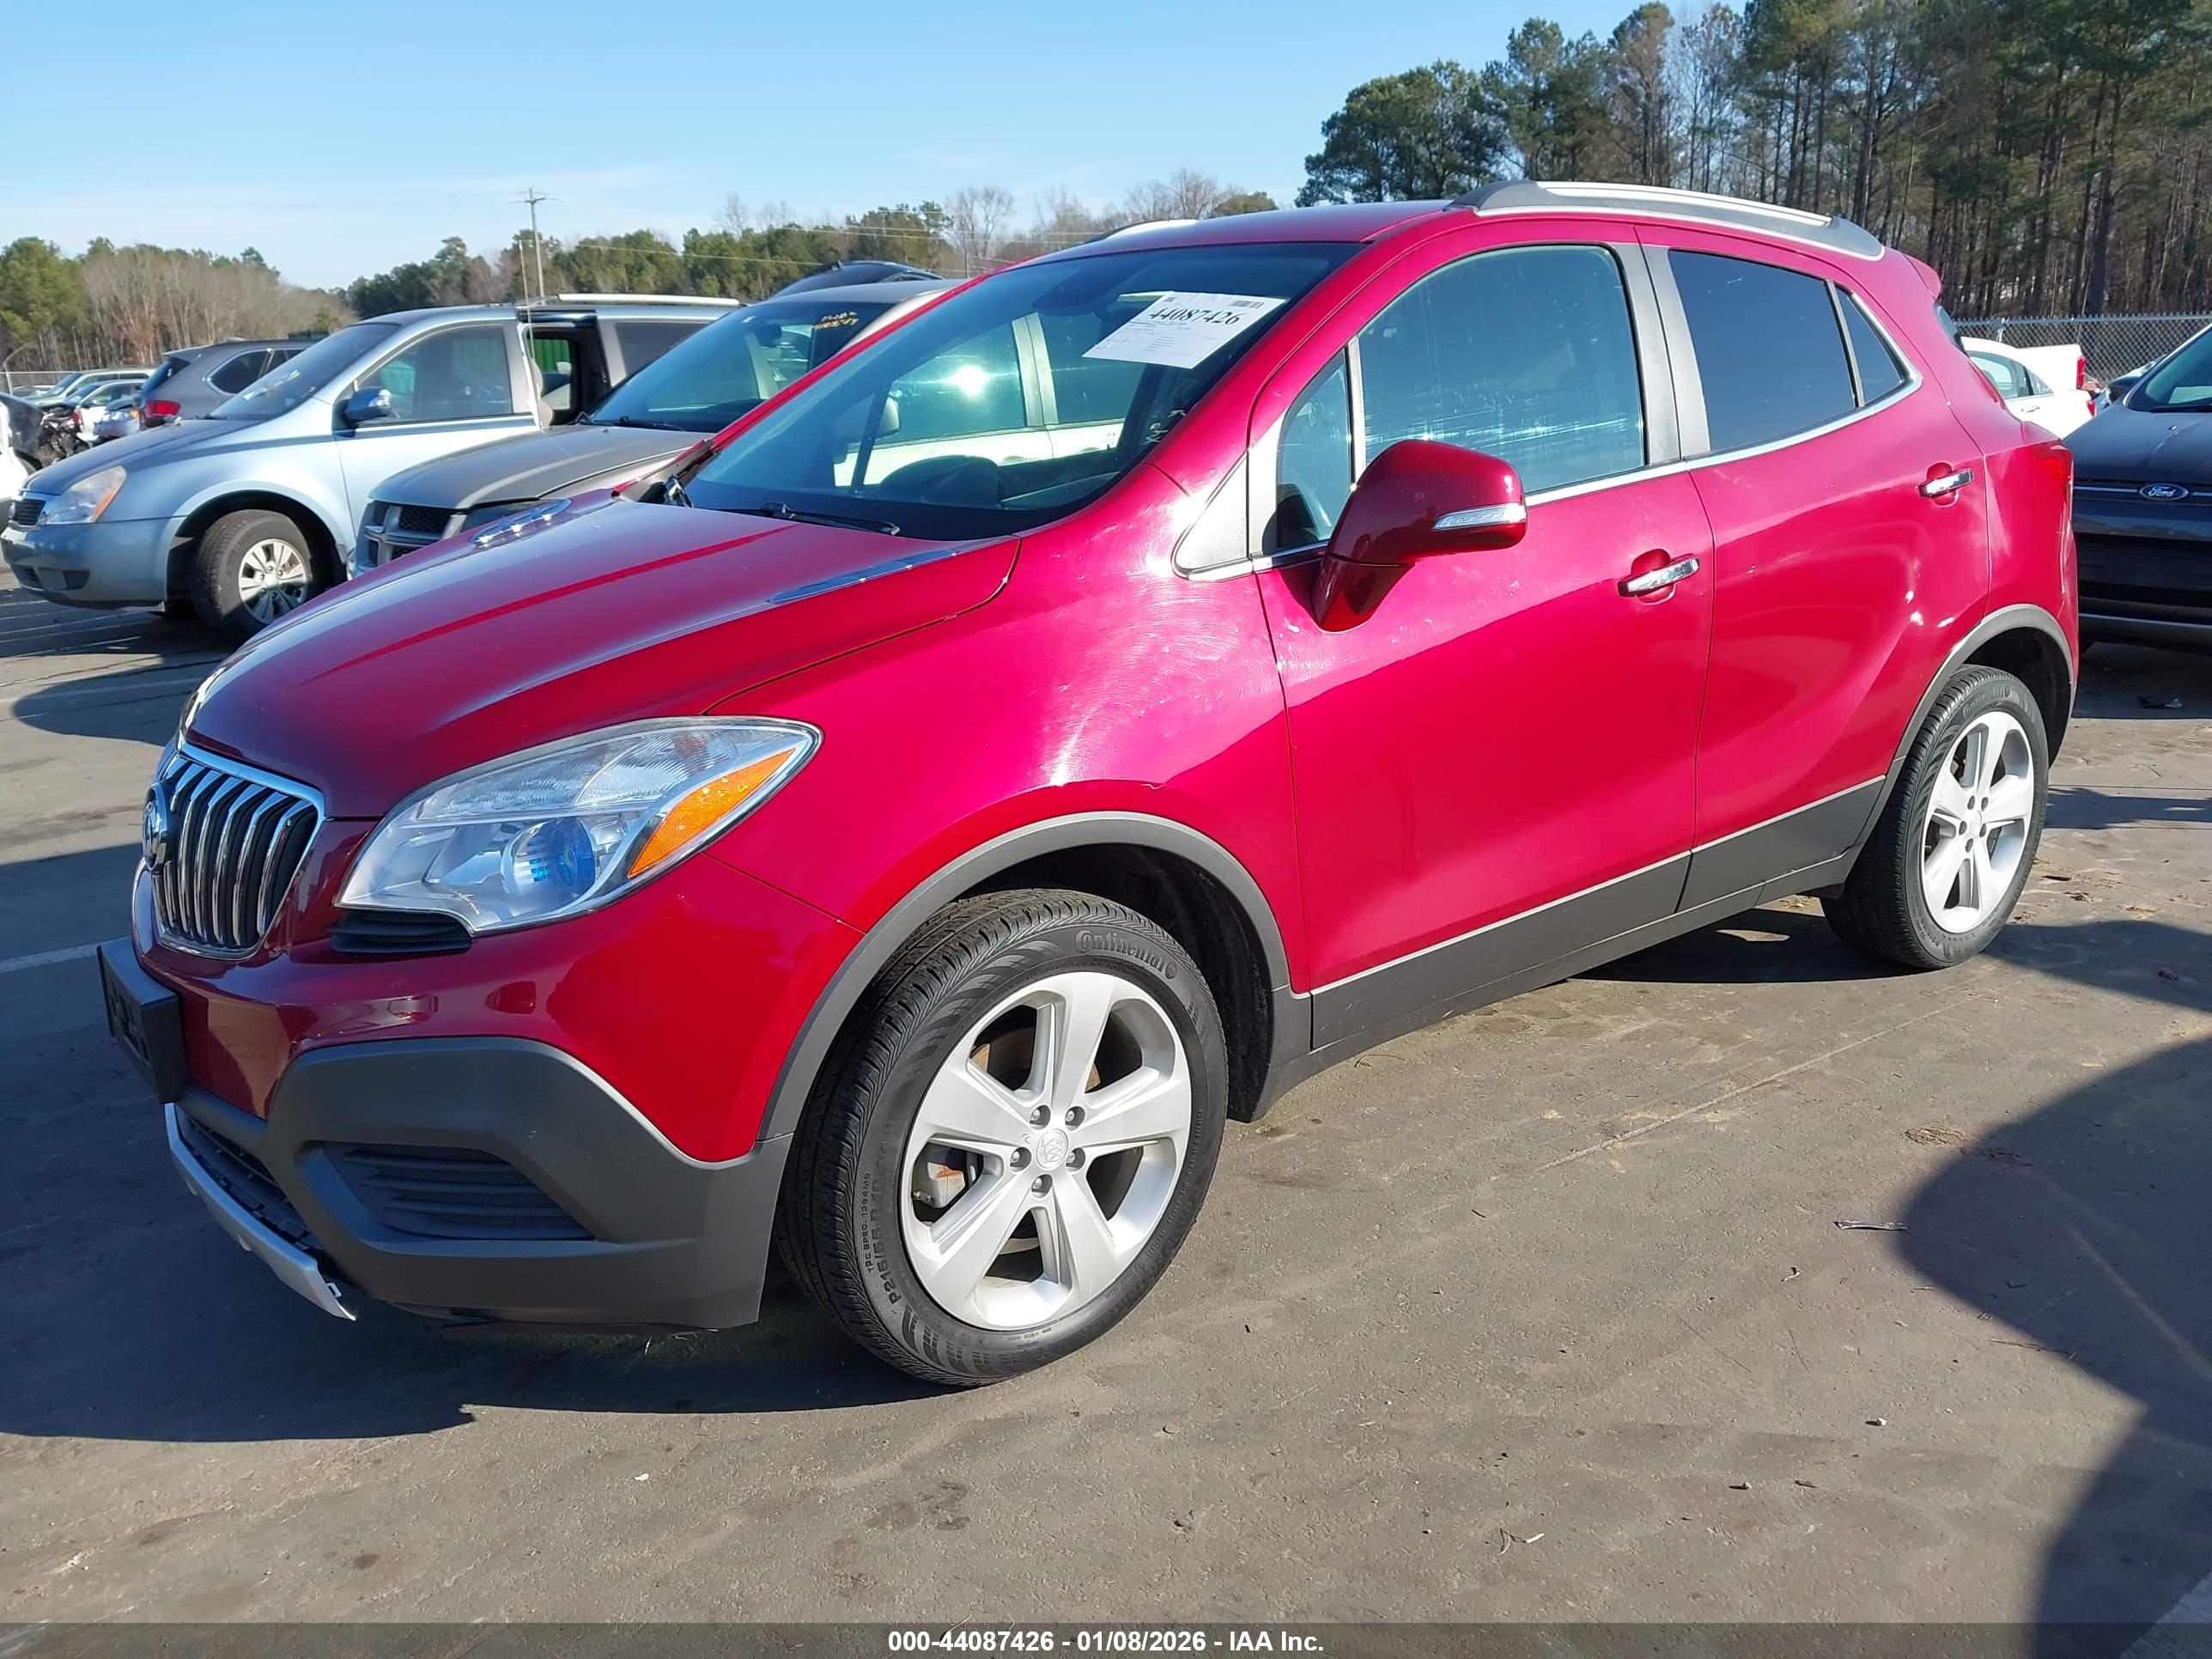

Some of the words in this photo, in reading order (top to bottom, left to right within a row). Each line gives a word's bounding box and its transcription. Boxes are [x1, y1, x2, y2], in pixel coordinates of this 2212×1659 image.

[1149, 307, 1248, 325] 44087426
[2148, 486, 2176, 497] Ford
[1075, 930, 1164, 971] Continental
